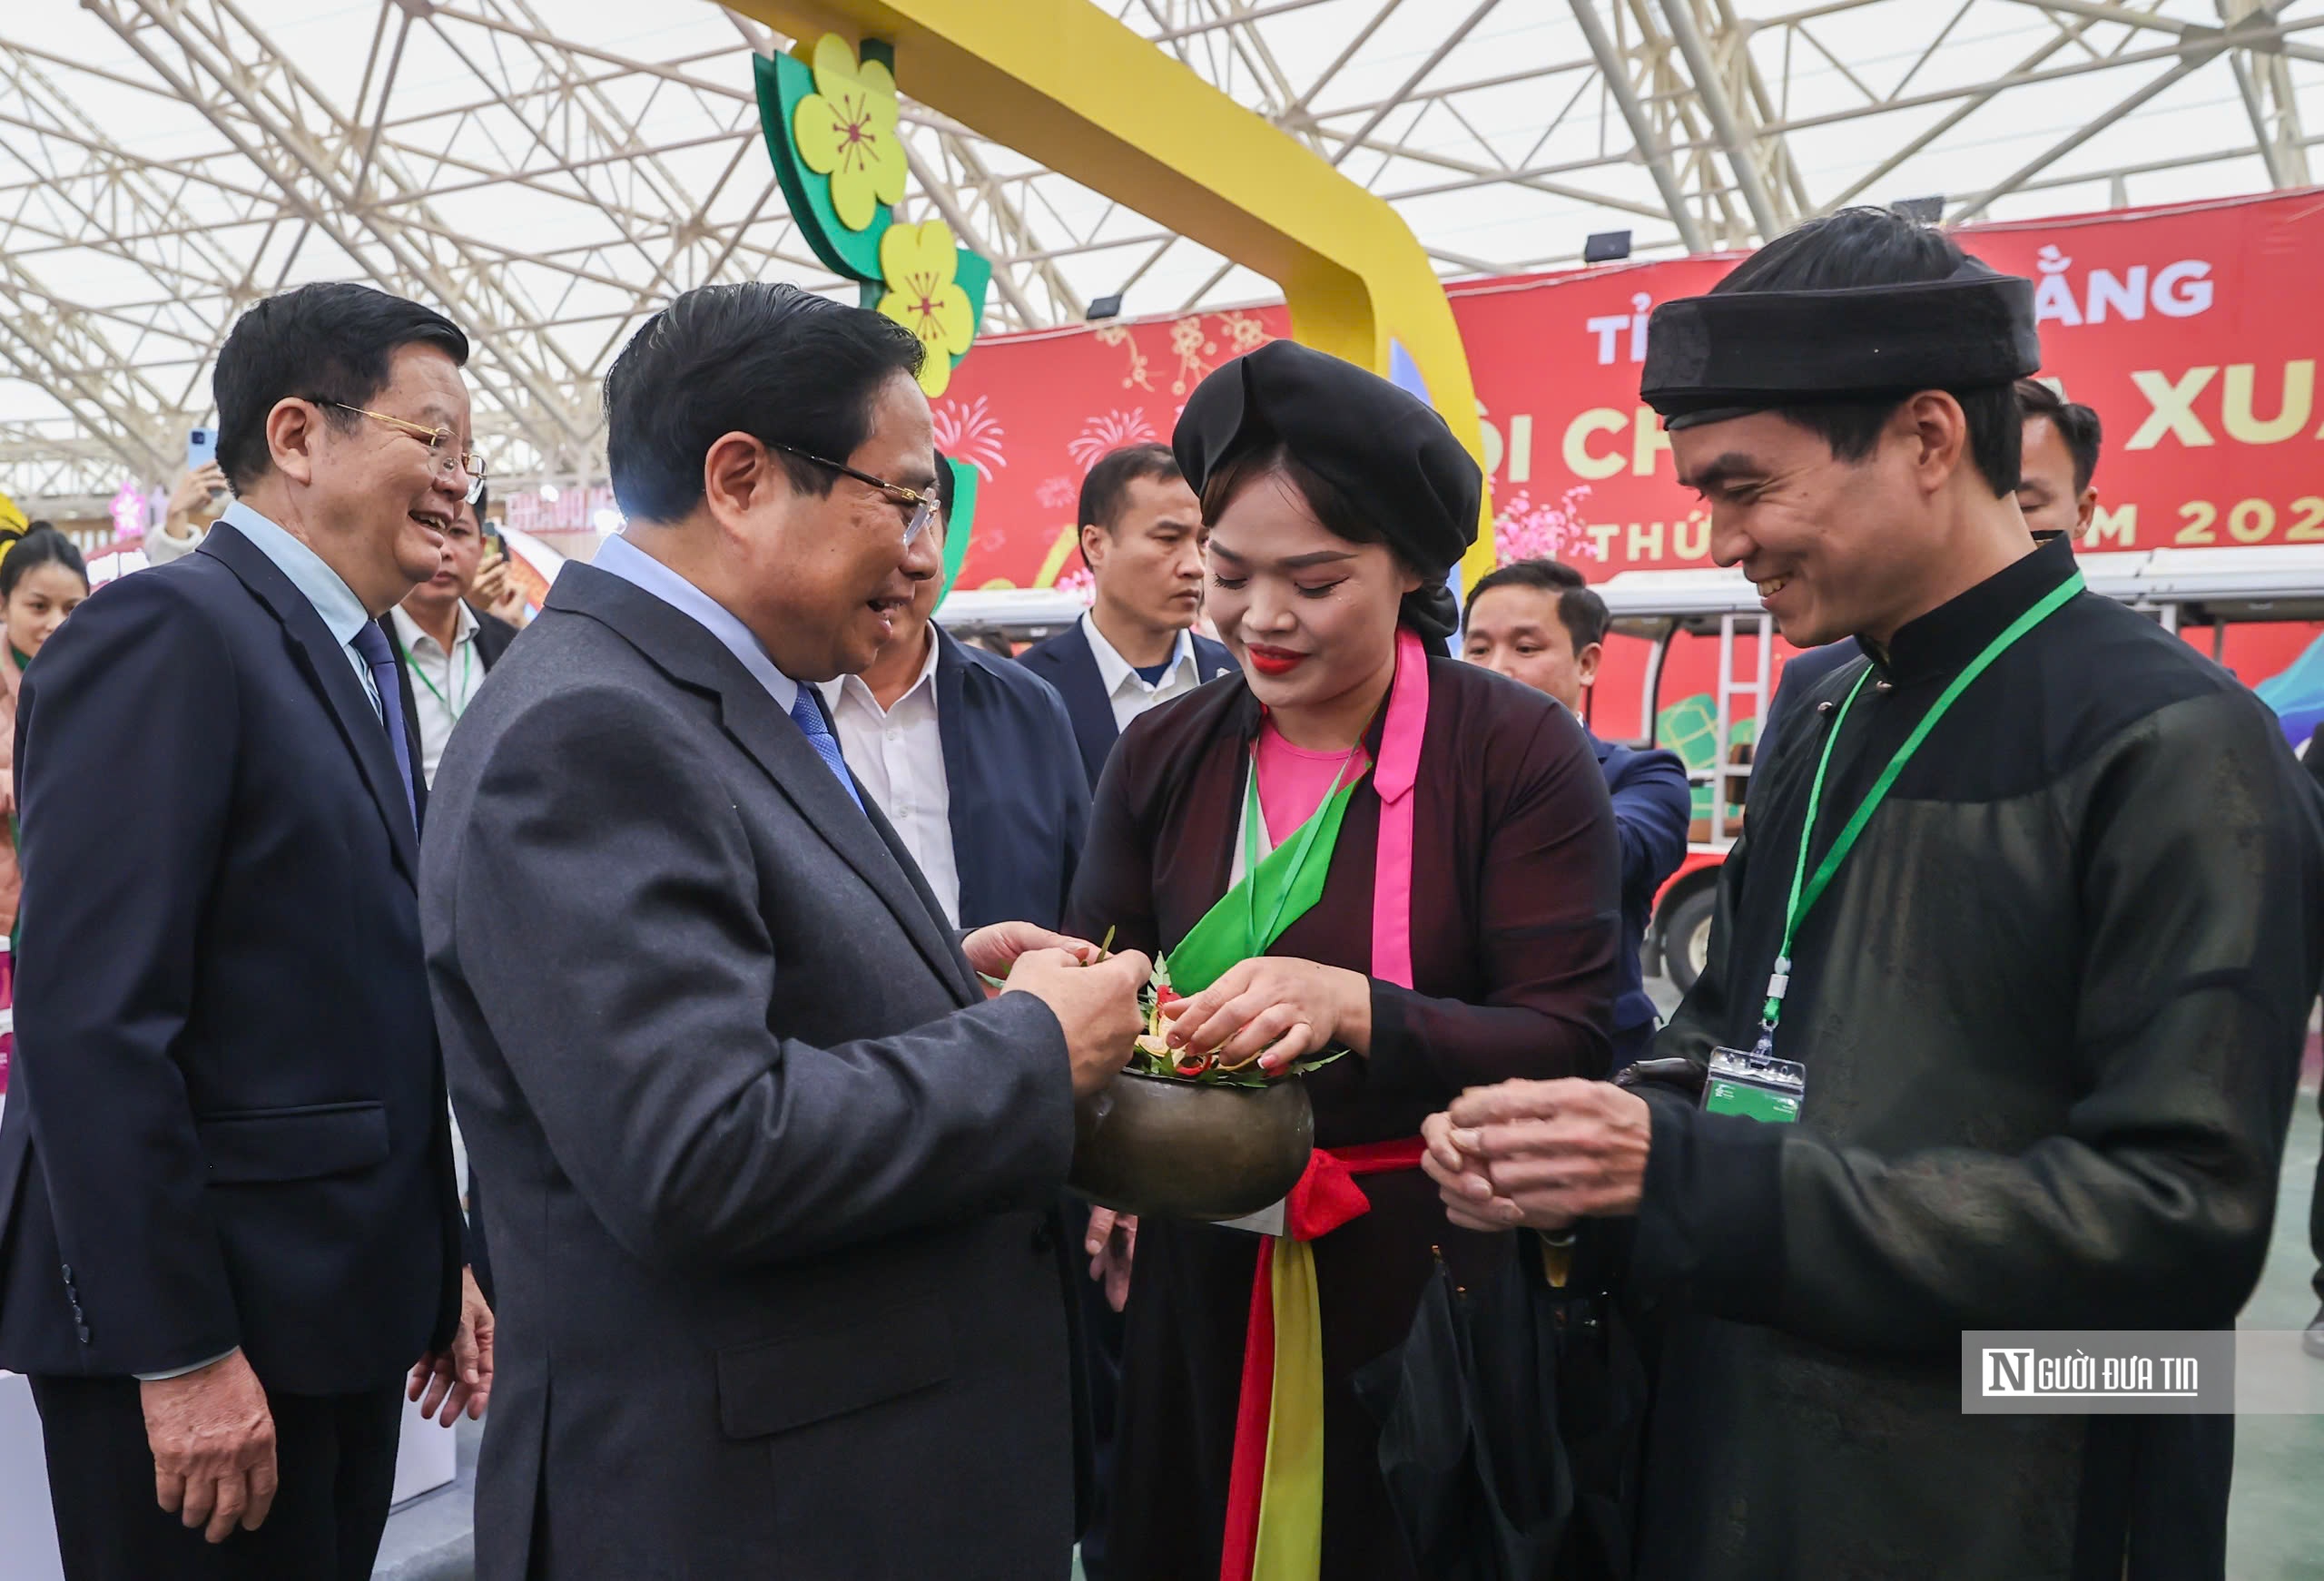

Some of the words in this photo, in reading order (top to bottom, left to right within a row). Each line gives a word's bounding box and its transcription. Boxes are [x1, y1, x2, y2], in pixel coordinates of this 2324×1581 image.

[1587, 292, 1651, 365] TỈ
[2035, 244, 2214, 327] ẰNG
[1562, 408, 1675, 480] CH
[2124, 358, 2324, 451] XU
